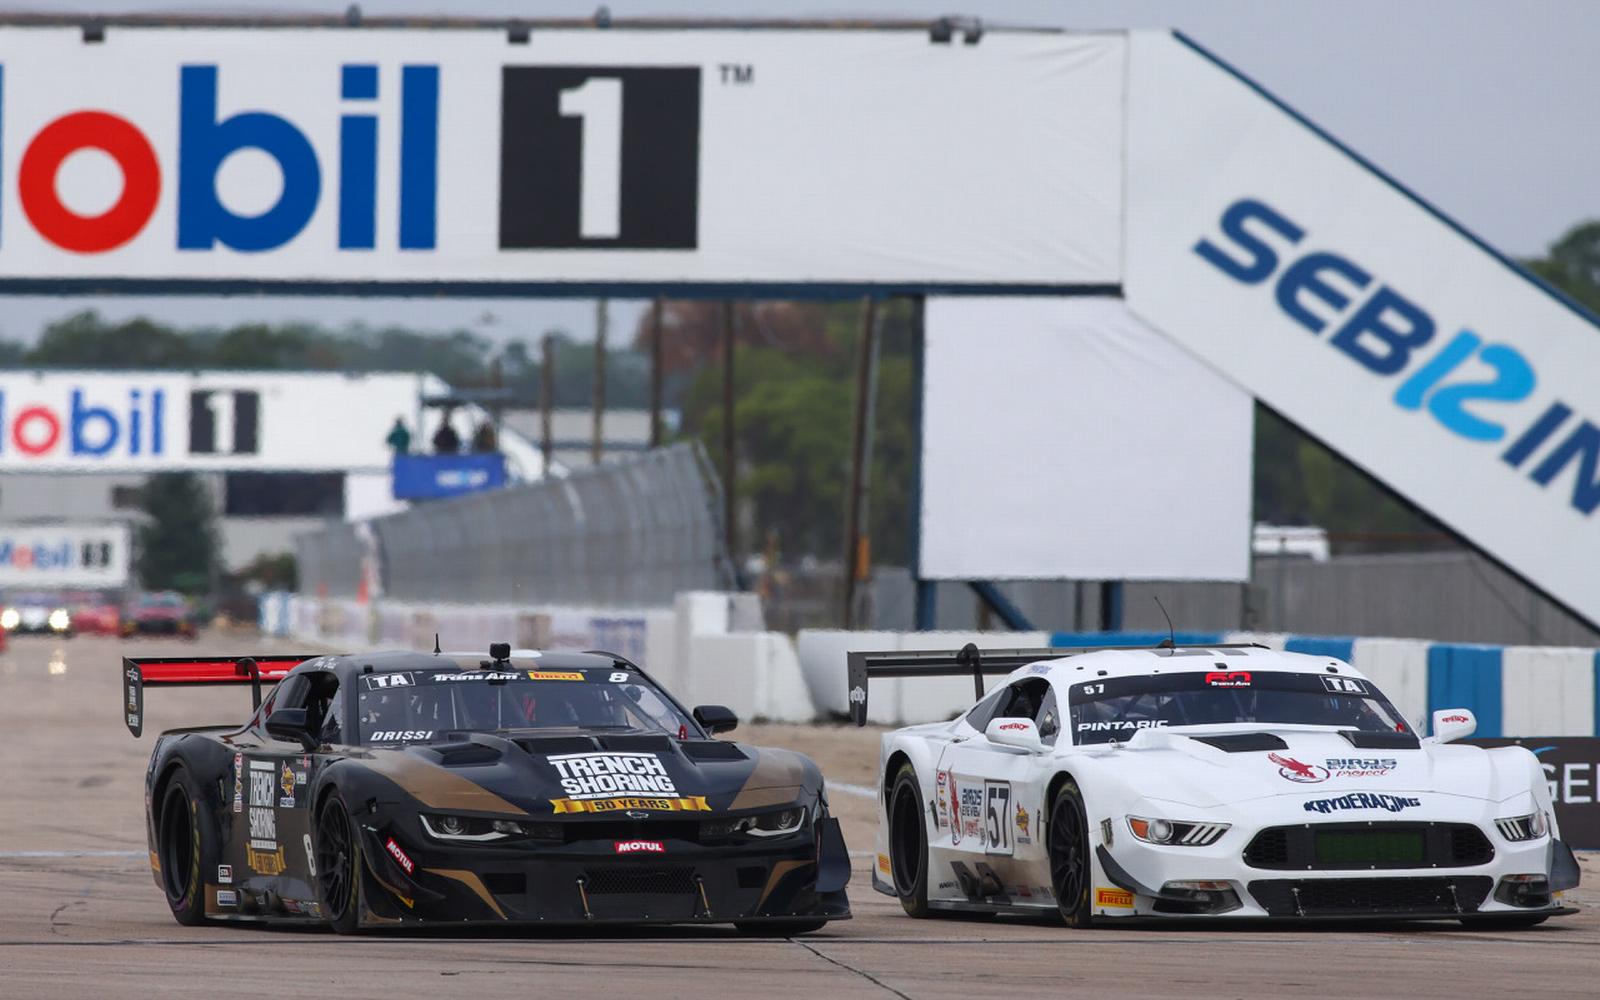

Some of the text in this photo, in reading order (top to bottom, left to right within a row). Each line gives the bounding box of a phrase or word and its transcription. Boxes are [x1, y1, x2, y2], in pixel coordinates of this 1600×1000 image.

[0, 63, 754, 254] obil 1 TM
[0, 388, 164, 456] obil
[372, 674, 409, 688] TA
[608, 671, 629, 682] 8
[1326, 676, 1363, 692] TA
[1083, 684, 1104, 695] 57
[1077, 720, 1169, 732] PINTARIC
[370, 731, 434, 742] DRISSI
[549, 755, 669, 779] TRENCH
[560, 774, 676, 794] SHORING
[593, 798, 670, 811] 50 YEARS
[988, 787, 1009, 849] 57
[618, 841, 663, 852] MOTUL
[303, 833, 317, 877] 8
[387, 841, 413, 873] MOTUL
